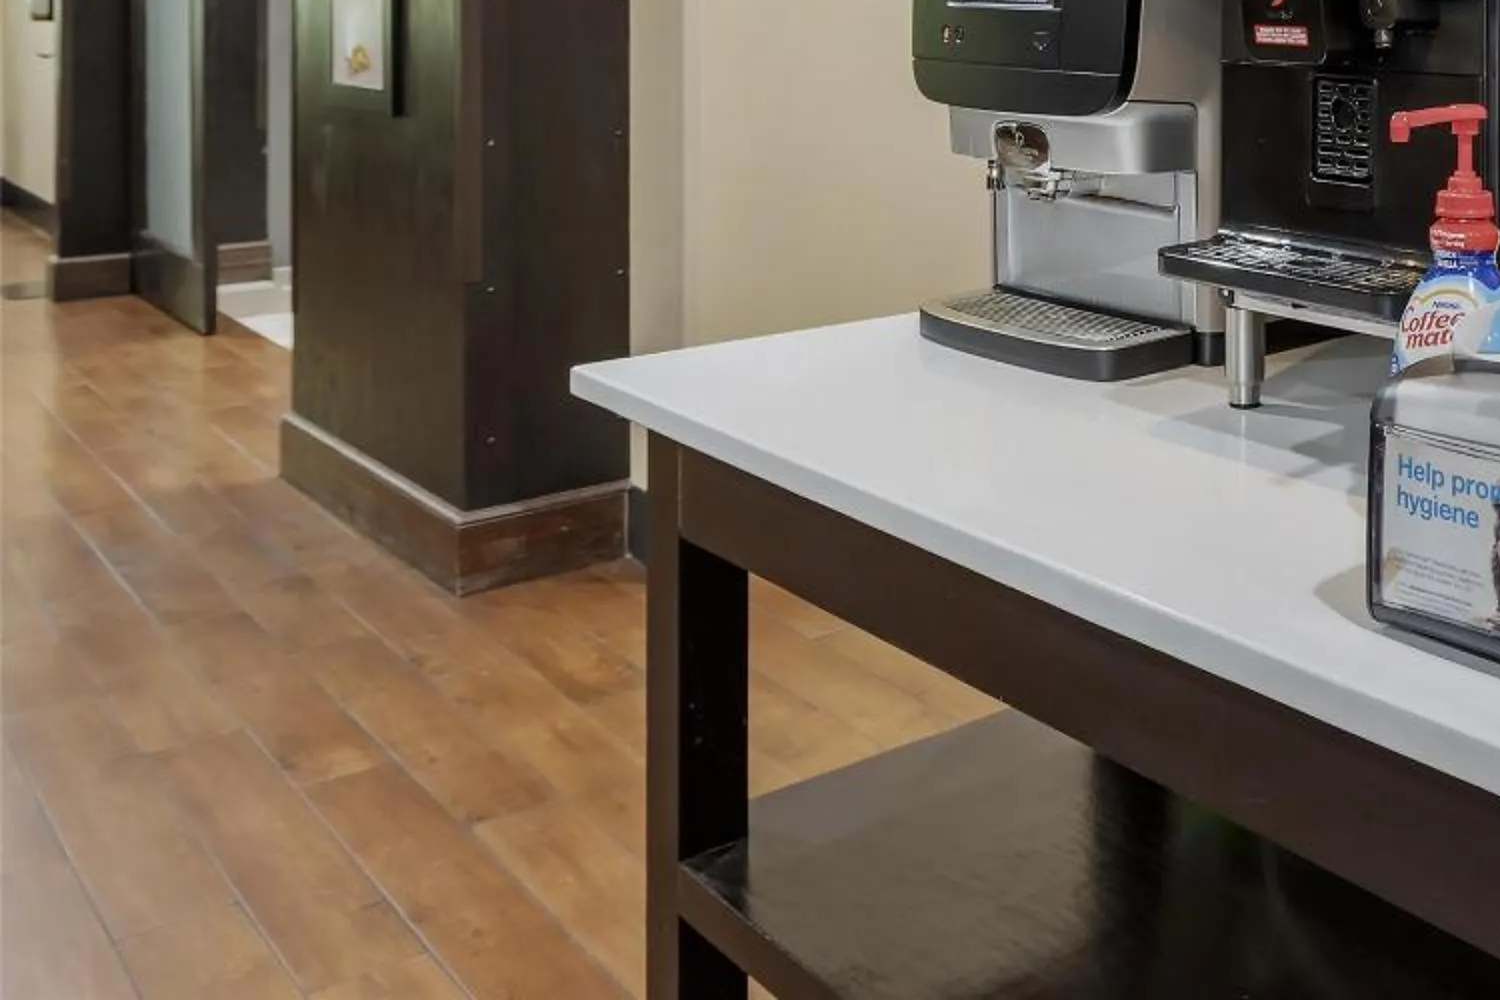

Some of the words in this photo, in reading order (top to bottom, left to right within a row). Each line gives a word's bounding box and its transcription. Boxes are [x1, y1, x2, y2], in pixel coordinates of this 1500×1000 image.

[1406, 328, 1454, 350] mat
[1397, 454, 1445, 492] Help
[1396, 484, 1480, 529] hygiene
